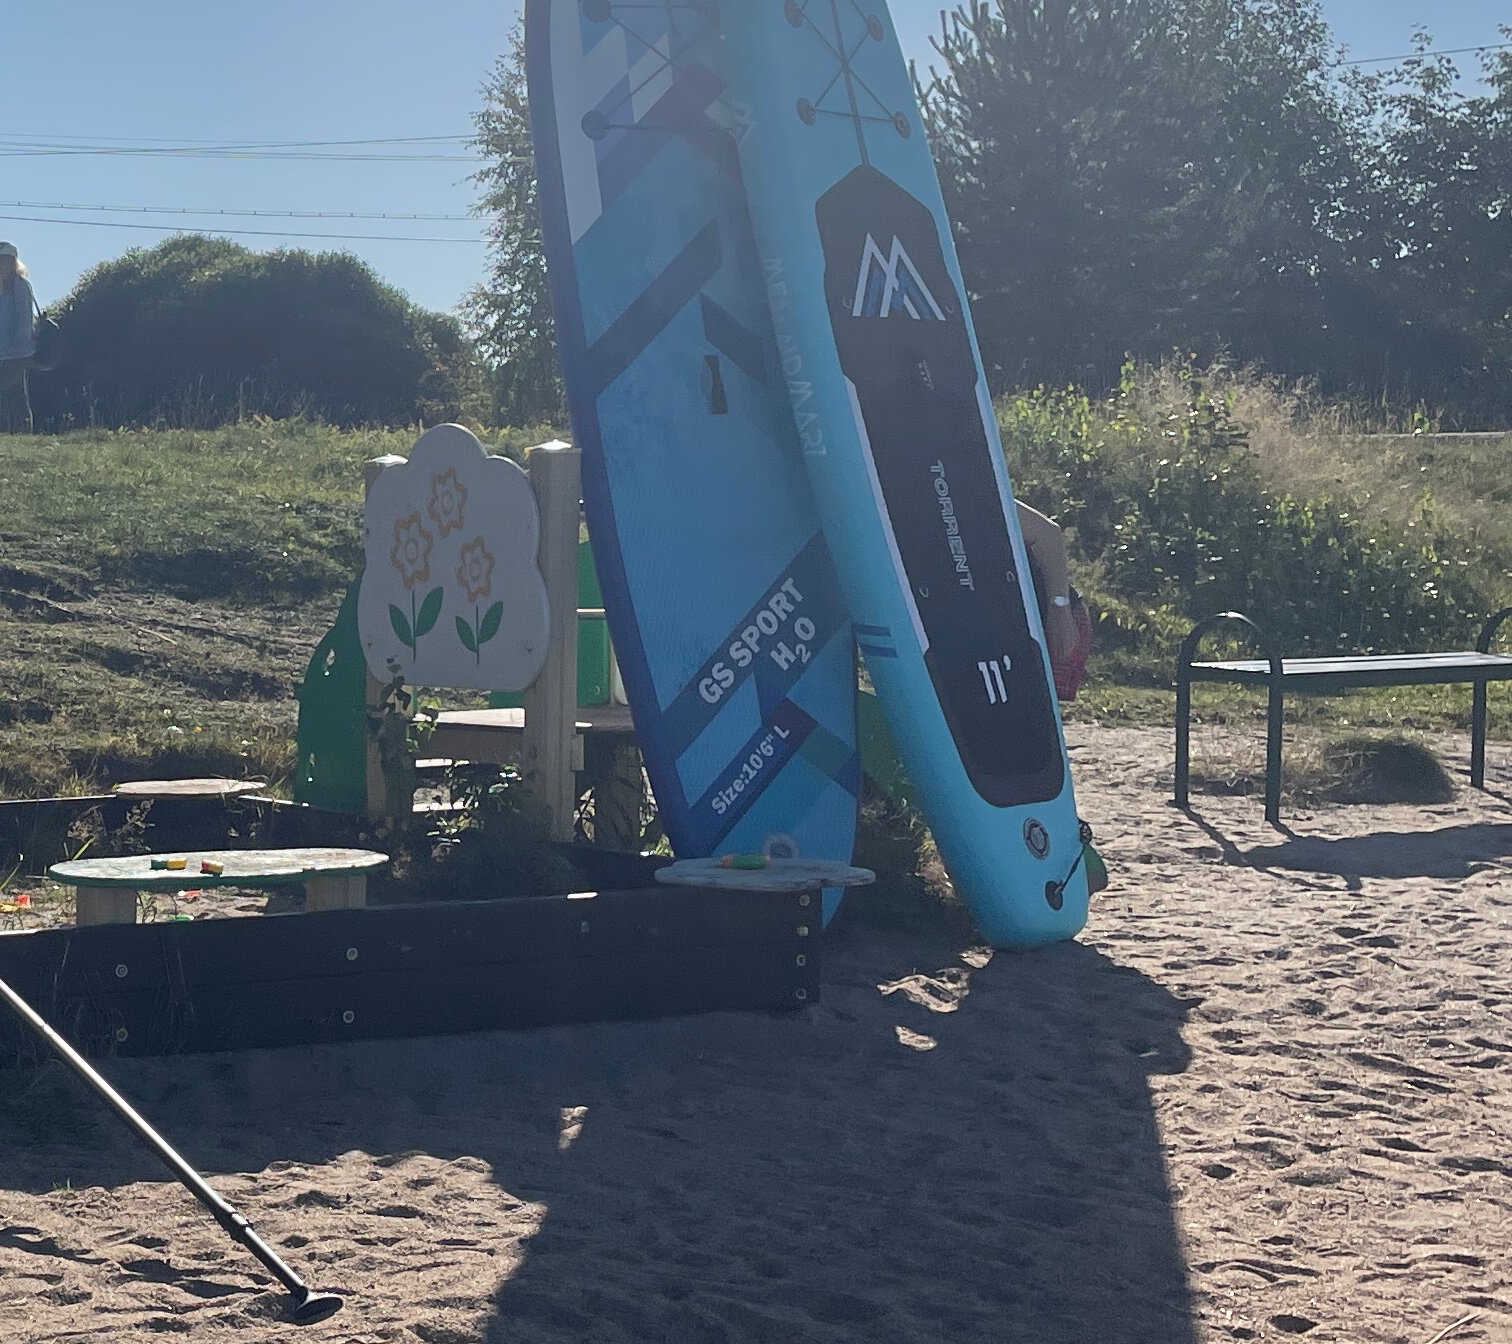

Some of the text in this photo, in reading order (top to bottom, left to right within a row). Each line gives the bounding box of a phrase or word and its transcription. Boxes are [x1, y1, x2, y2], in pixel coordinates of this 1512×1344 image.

[930, 460, 975, 591] TORRENT
[698, 577, 804, 704] GS SPORT
[773, 725, 790, 739] L
